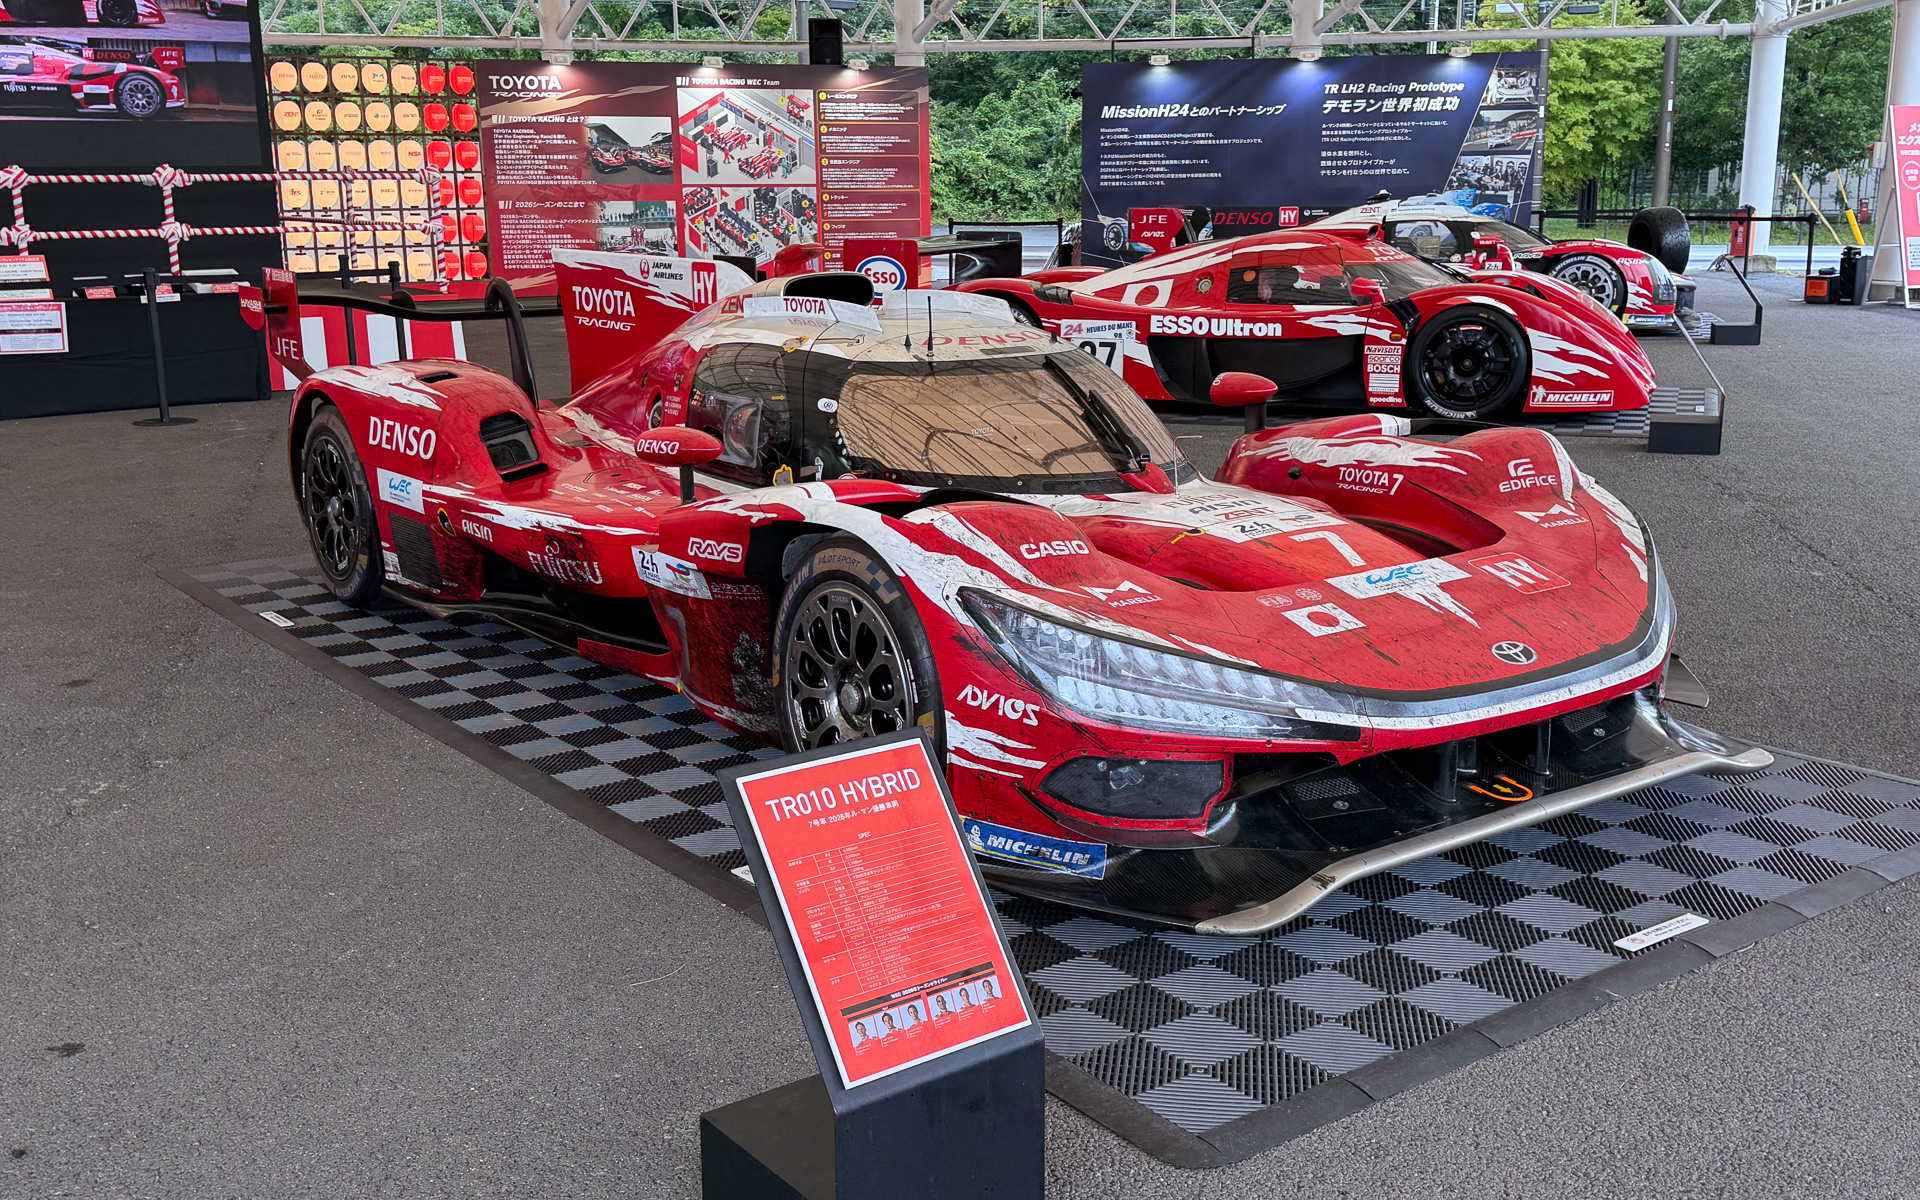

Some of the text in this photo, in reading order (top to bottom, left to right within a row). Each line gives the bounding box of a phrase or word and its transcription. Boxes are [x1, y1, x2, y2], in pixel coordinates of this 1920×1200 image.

[96, 51, 131, 60] DENSO
[4, 81, 27, 93] FUJITSU
[489, 75, 562, 90] TOYOTA
[691, 77, 719, 85] TOYOTA
[1324, 81, 1465, 94] TR LH2 Racing Prototype
[1322, 95, 1461, 115] デモラン世界初成功
[1213, 211, 1274, 226] DENSO
[1279, 209, 1297, 224] HY
[1360, 206, 1382, 214] ZENT
[1138, 214, 1168, 225] JFE
[651, 261, 673, 271] JAPAN
[1555, 255, 1586, 271] MICHELIN
[653, 271, 684, 281] AIRLINES
[692, 270, 716, 305] HY
[572, 286, 636, 317] TOYOTA
[783, 297, 826, 315] TOYOTA
[574, 315, 636, 332] RACING
[1063, 321, 1133, 337] 24 HEURES DU MANS
[922, 330, 1044, 347] DENSO
[275, 336, 300, 361] JFE
[1365, 346, 1401, 354] Navisoft
[1368, 355, 1400, 363] sparco
[1367, 364, 1401, 373] BOSCH
[1369, 396, 1403, 404] speedline
[1547, 393, 1612, 402] MICHELIN
[368, 415, 437, 460] DENSO
[970, 427, 994, 436] TOYOTA
[636, 438, 680, 456] DENSO
[389, 477, 412, 495] WEC
[1336, 482, 1389, 495] RACING
[1338, 467, 1405, 496] TOYOTA 7
[1499, 474, 1558, 493] EDIFICE
[1188, 499, 1263, 515] AISIN
[1214, 506, 1277, 521] ZENT
[461, 519, 494, 543] AISIN
[1540, 517, 1590, 529] MARELLI
[687, 536, 743, 563] RAYS
[1020, 540, 1090, 560] CASIO
[1288, 530, 1368, 568] 7
[527, 540, 603, 585] FUJITSU
[818, 554, 861, 568] PILOT SPORT
[1365, 564, 1424, 586] WEC
[1482, 557, 1550, 587] HY
[1107, 594, 1163, 608] MARELLI
[764, 767, 921, 823] TR010 HYBRID
[808, 800, 900, 829] 7号車 2026年ル・マン優勝車両
[857, 831, 872, 840] SPEC
[986, 834, 1091, 866] MICHELIN
